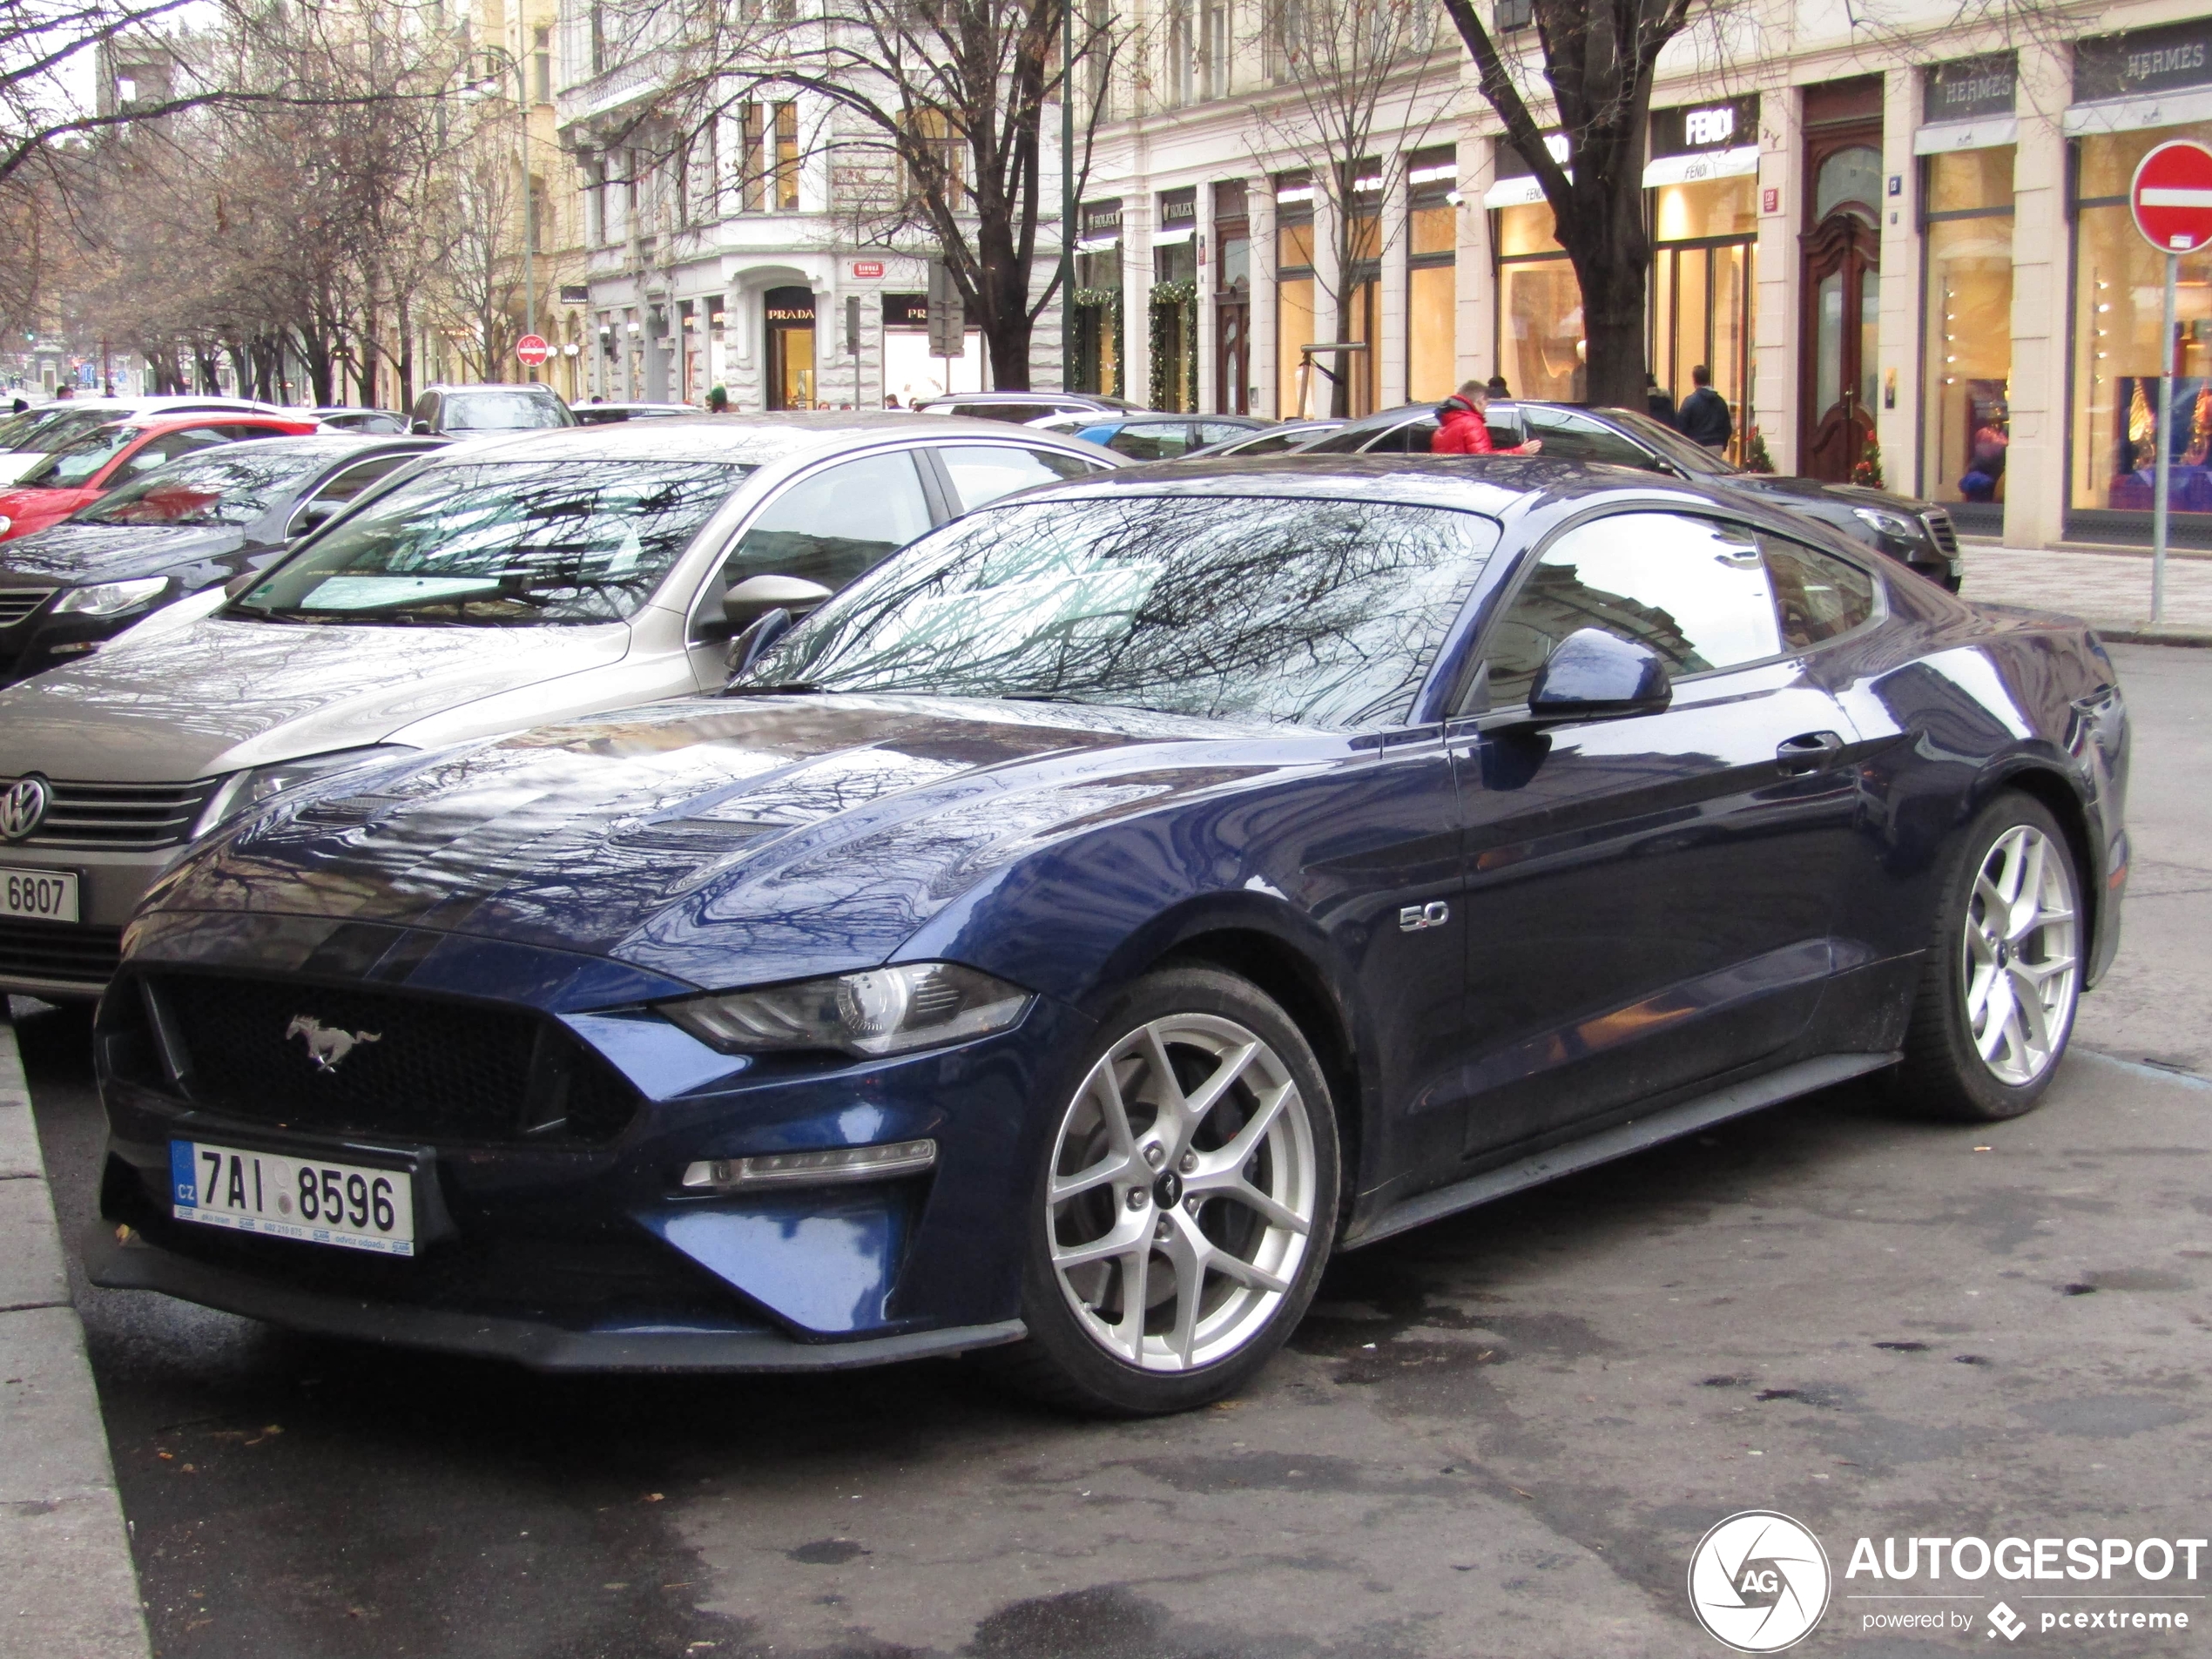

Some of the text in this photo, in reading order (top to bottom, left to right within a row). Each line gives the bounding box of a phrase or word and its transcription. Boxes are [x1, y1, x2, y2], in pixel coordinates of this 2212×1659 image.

[1686, 108, 1732, 145] FENDI
[1685, 164, 1709, 179] FENDI
[1170, 202, 1193, 219] ROLEX
[1094, 212, 1116, 228] ROLEX
[768, 309, 815, 320] PRADA
[9, 875, 64, 914] 6807
[1399, 900, 1449, 932] 5.0
[178, 1184, 195, 1201] CZ
[299, 1166, 395, 1231] 8596
